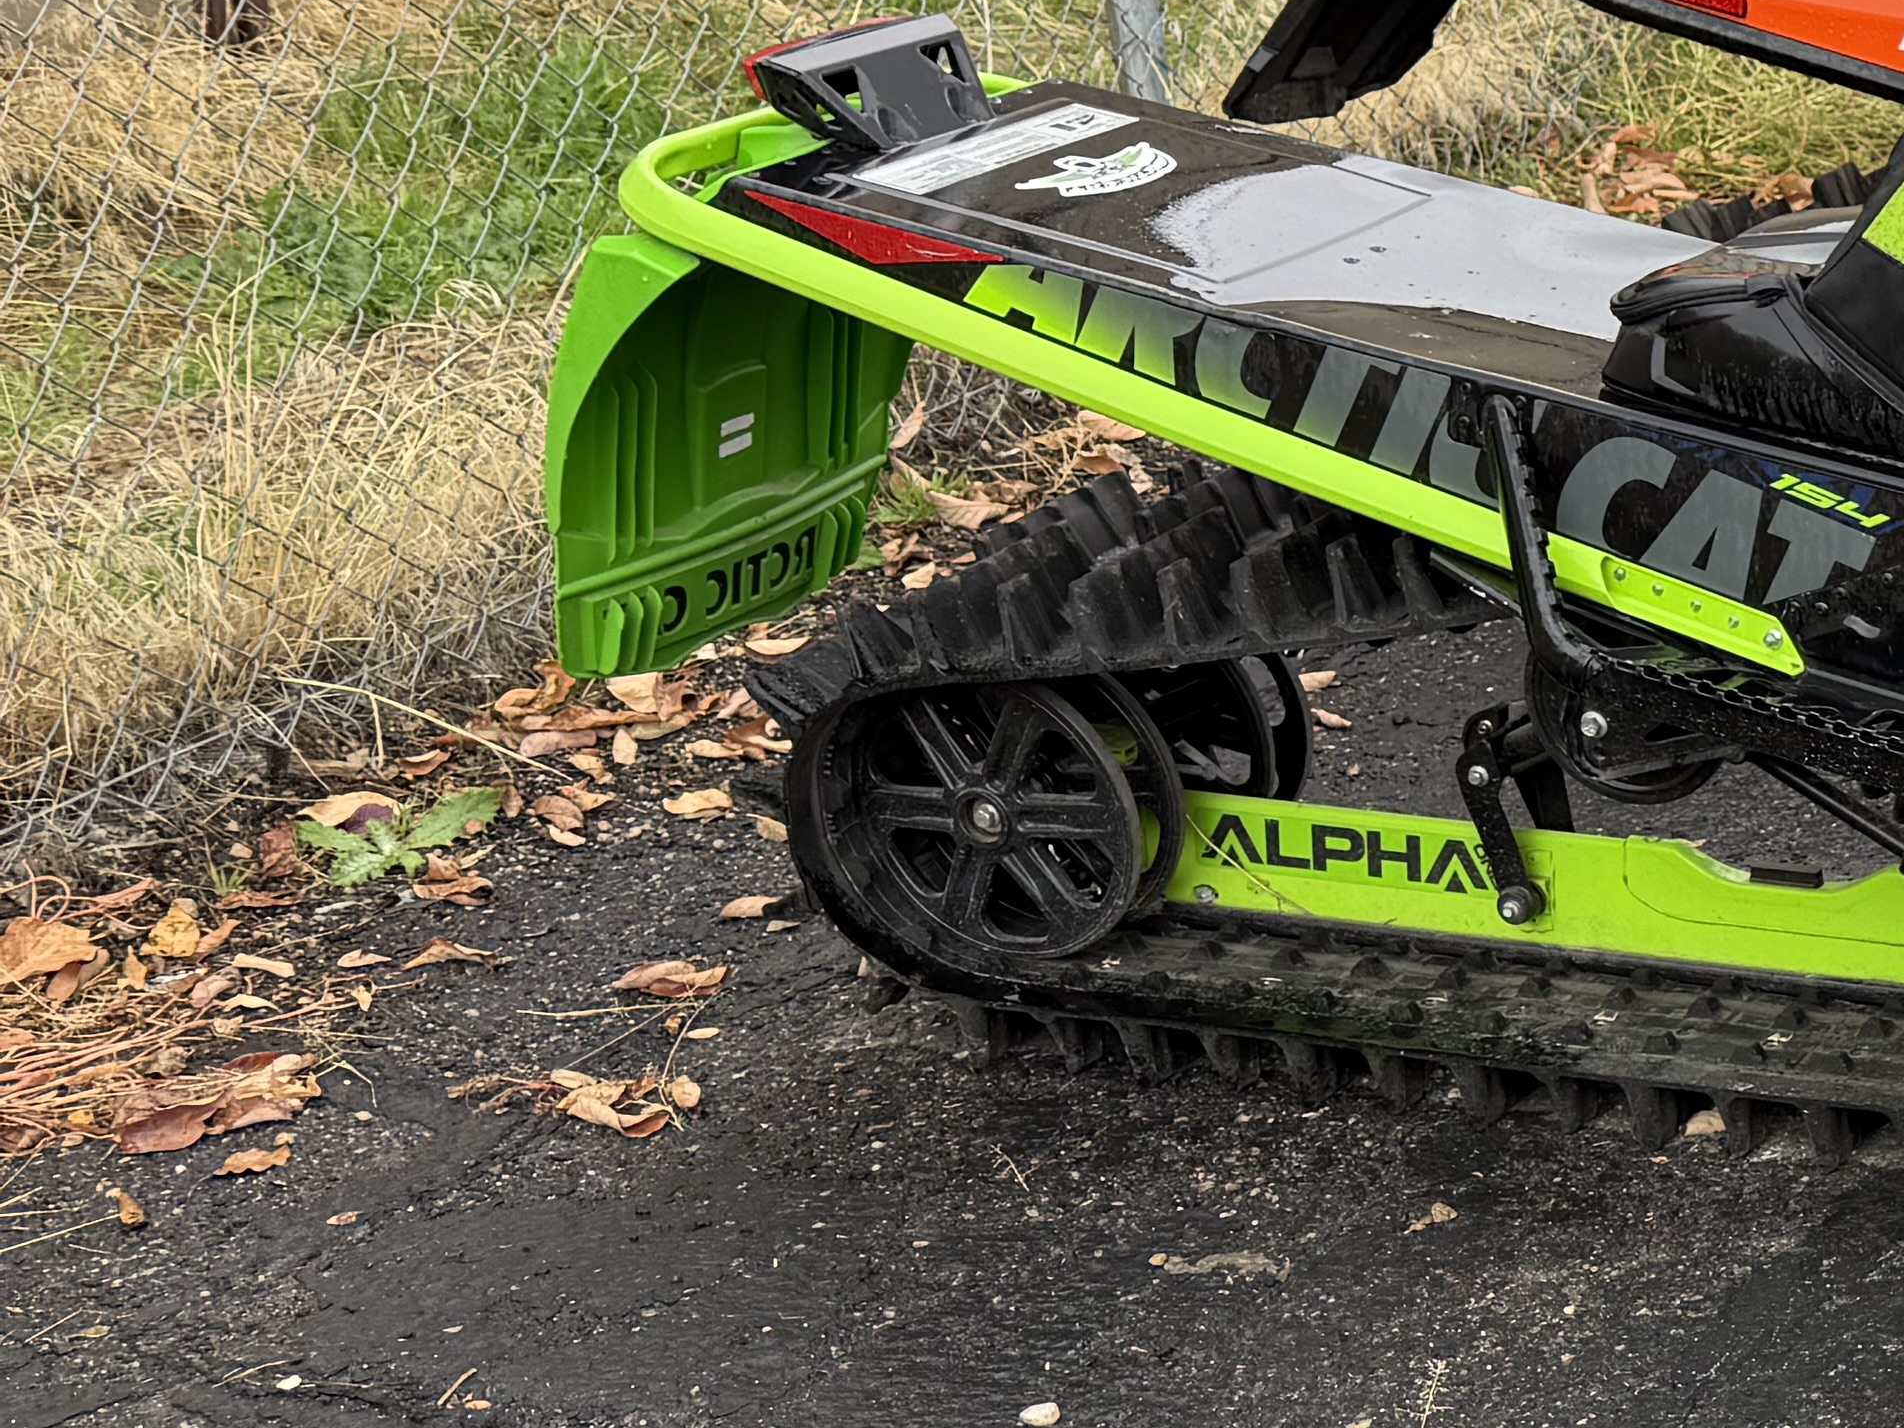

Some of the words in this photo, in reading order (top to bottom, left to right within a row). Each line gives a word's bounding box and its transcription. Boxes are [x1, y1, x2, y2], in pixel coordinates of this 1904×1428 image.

[1556, 436, 1878, 605] CAT
[1769, 473, 1891, 528] 154
[1201, 813, 1489, 894] ALPHA
